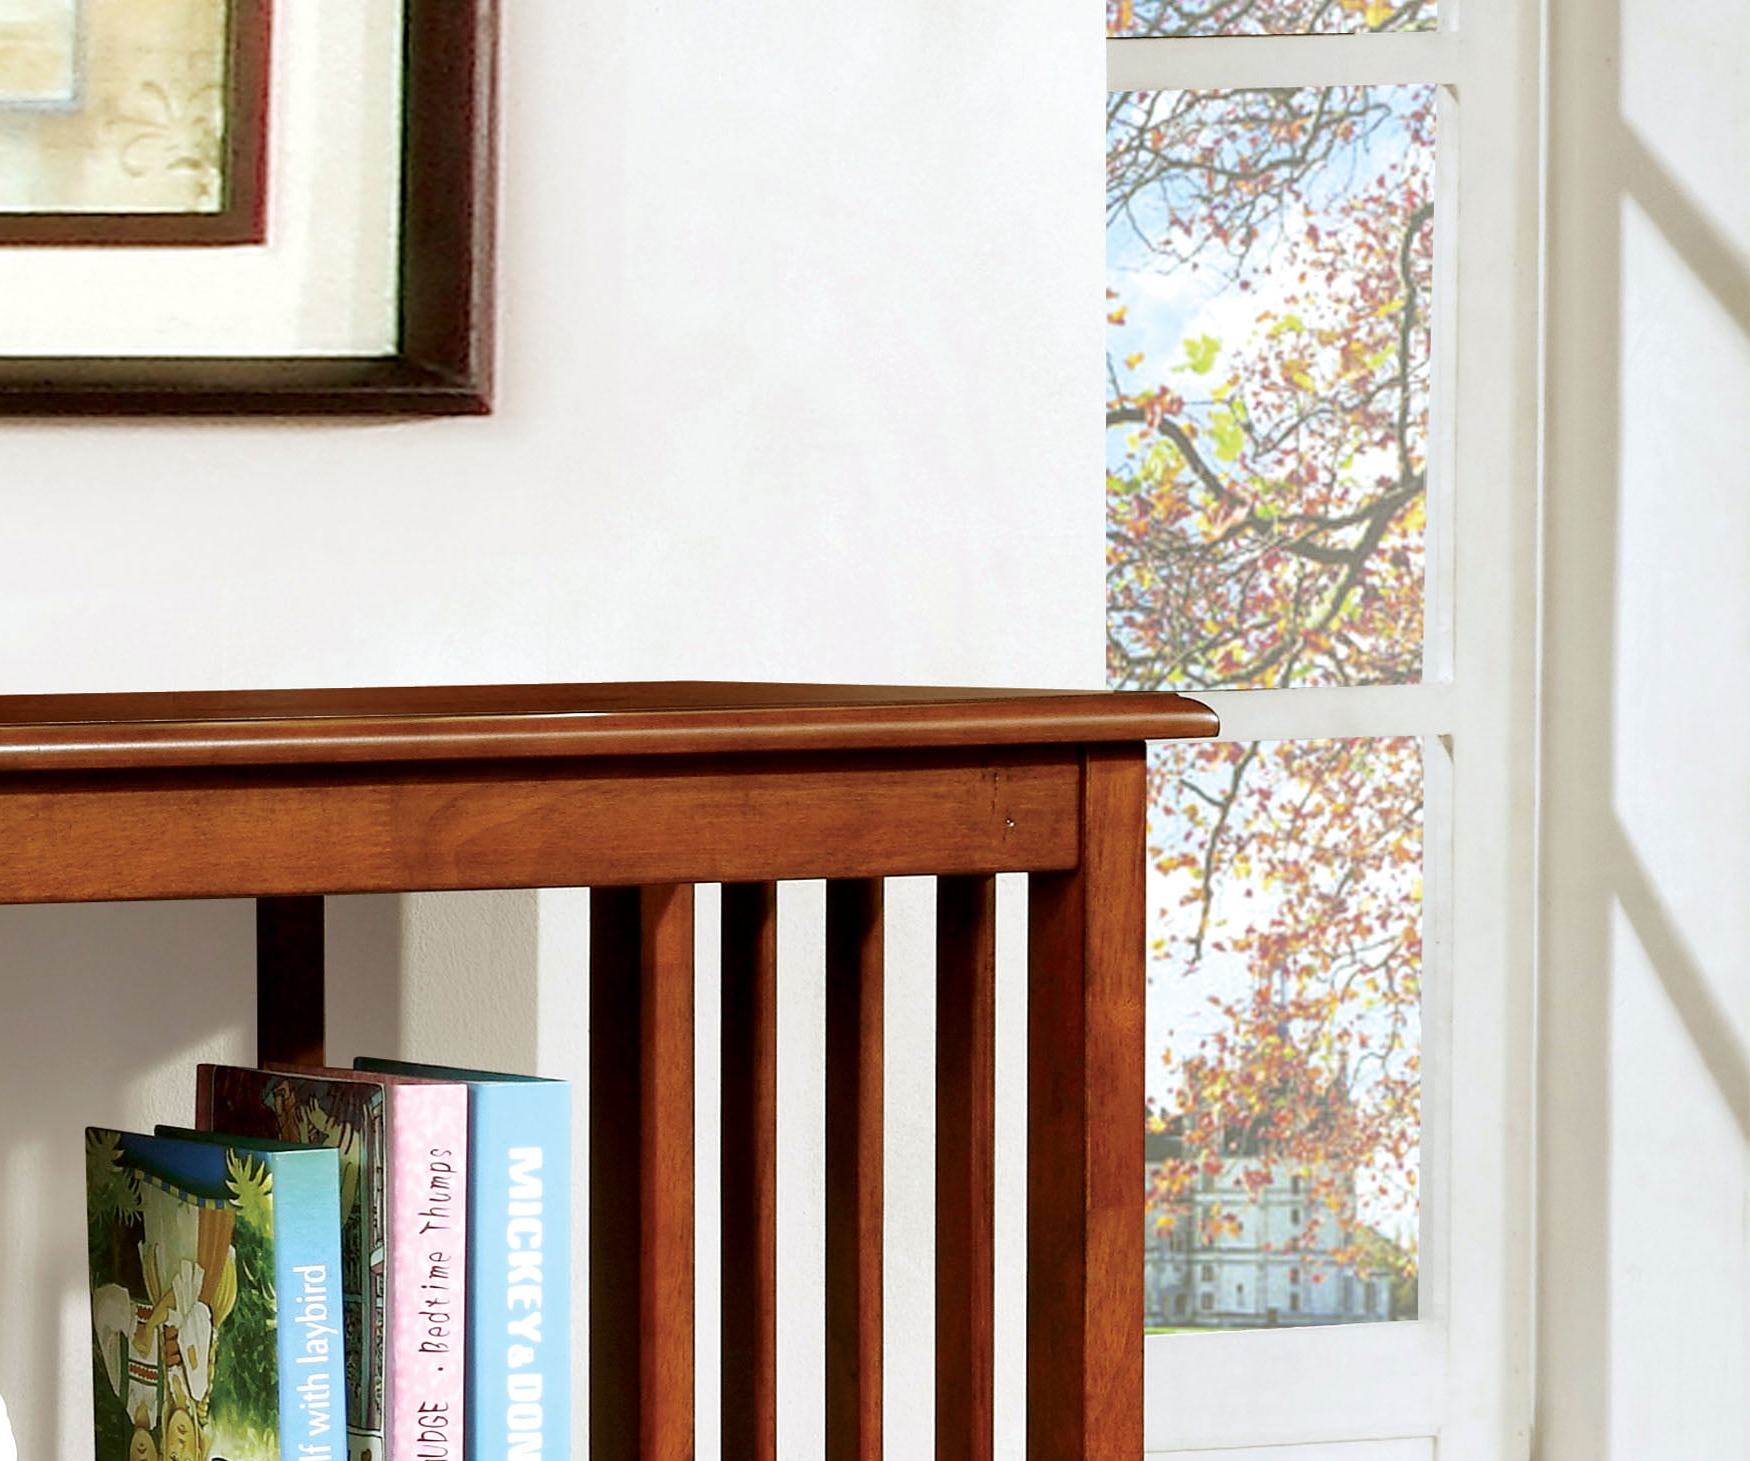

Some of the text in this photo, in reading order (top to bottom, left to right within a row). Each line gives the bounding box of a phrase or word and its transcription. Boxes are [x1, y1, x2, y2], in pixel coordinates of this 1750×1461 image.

[418, 1148, 457, 1234] Thumps
[293, 1265, 339, 1364] laybird
[296, 1373, 331, 1436] with
